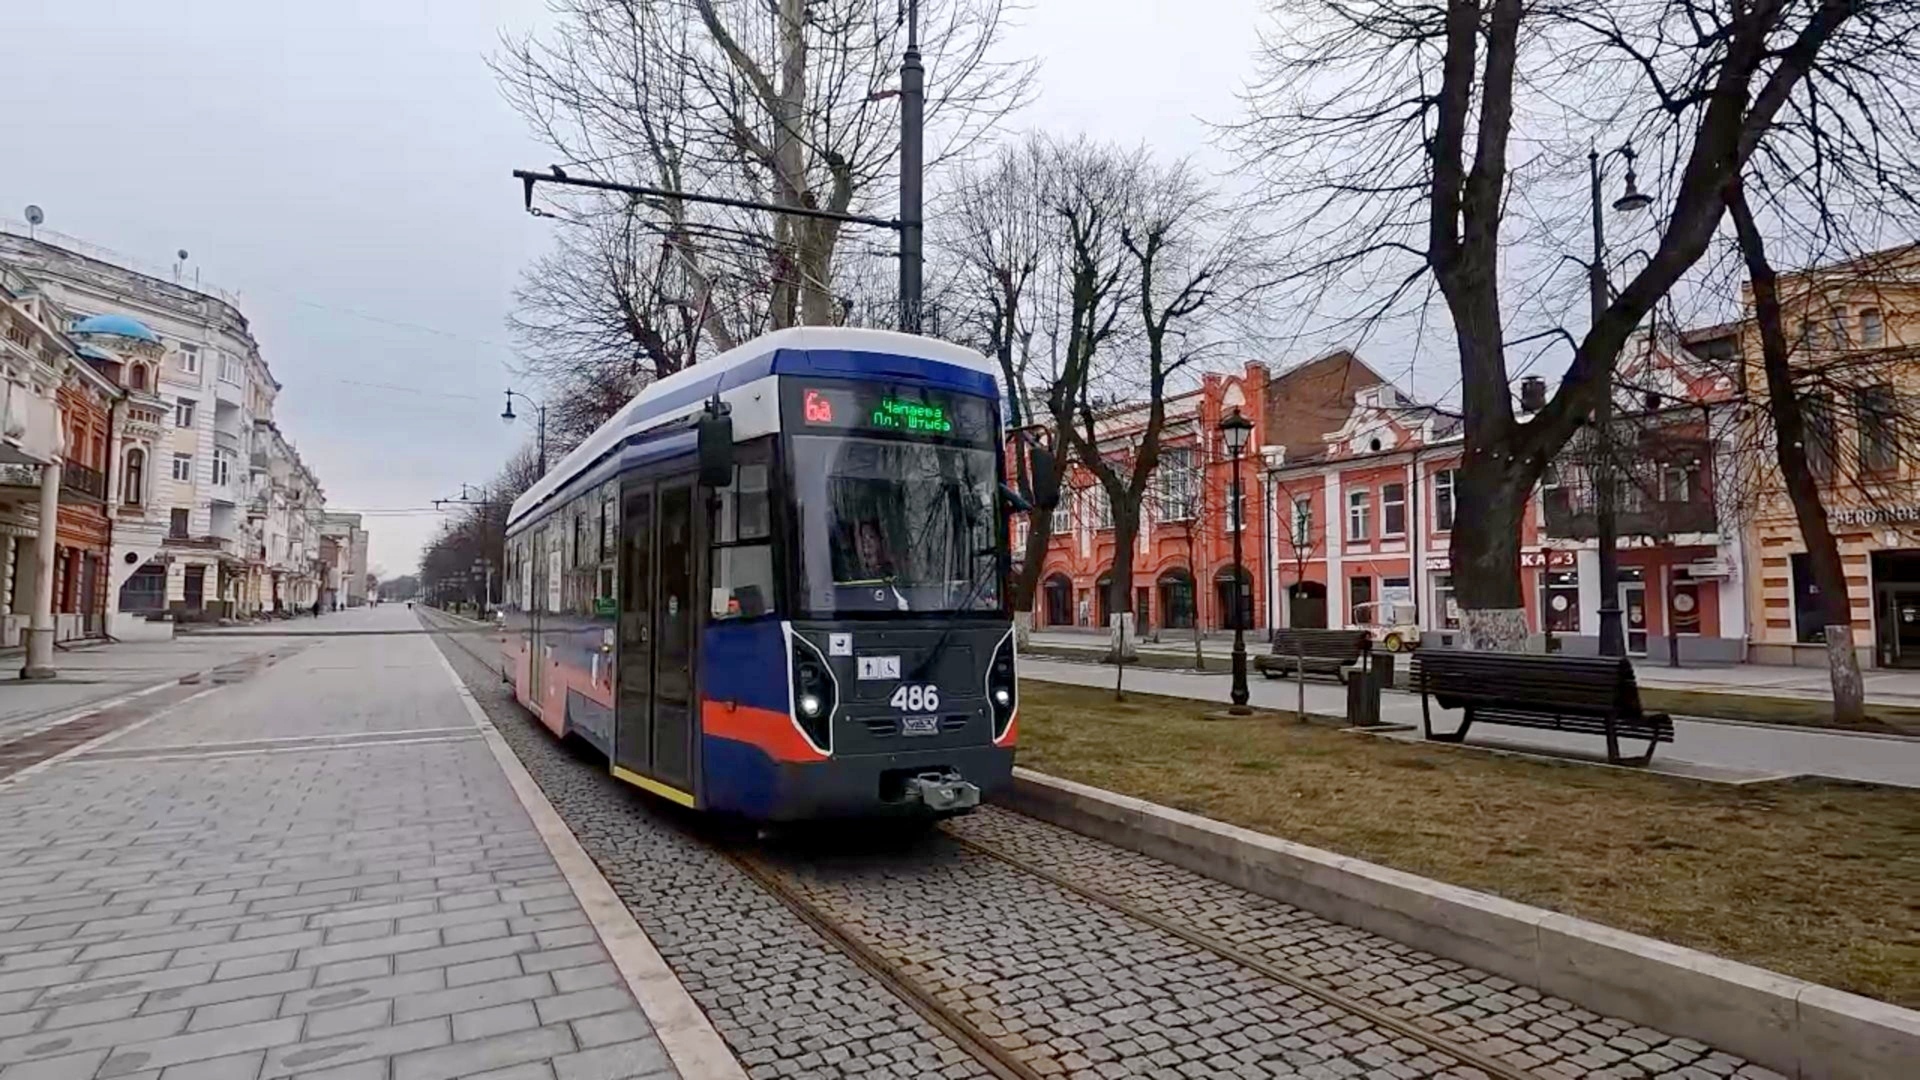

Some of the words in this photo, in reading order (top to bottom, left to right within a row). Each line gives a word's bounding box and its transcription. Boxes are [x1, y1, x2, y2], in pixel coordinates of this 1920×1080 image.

[882, 399, 942, 419] Чапаева
[873, 411, 899, 427] Пл.
[908, 414, 951, 432] Штыба
[890, 684, 939, 712] 486
